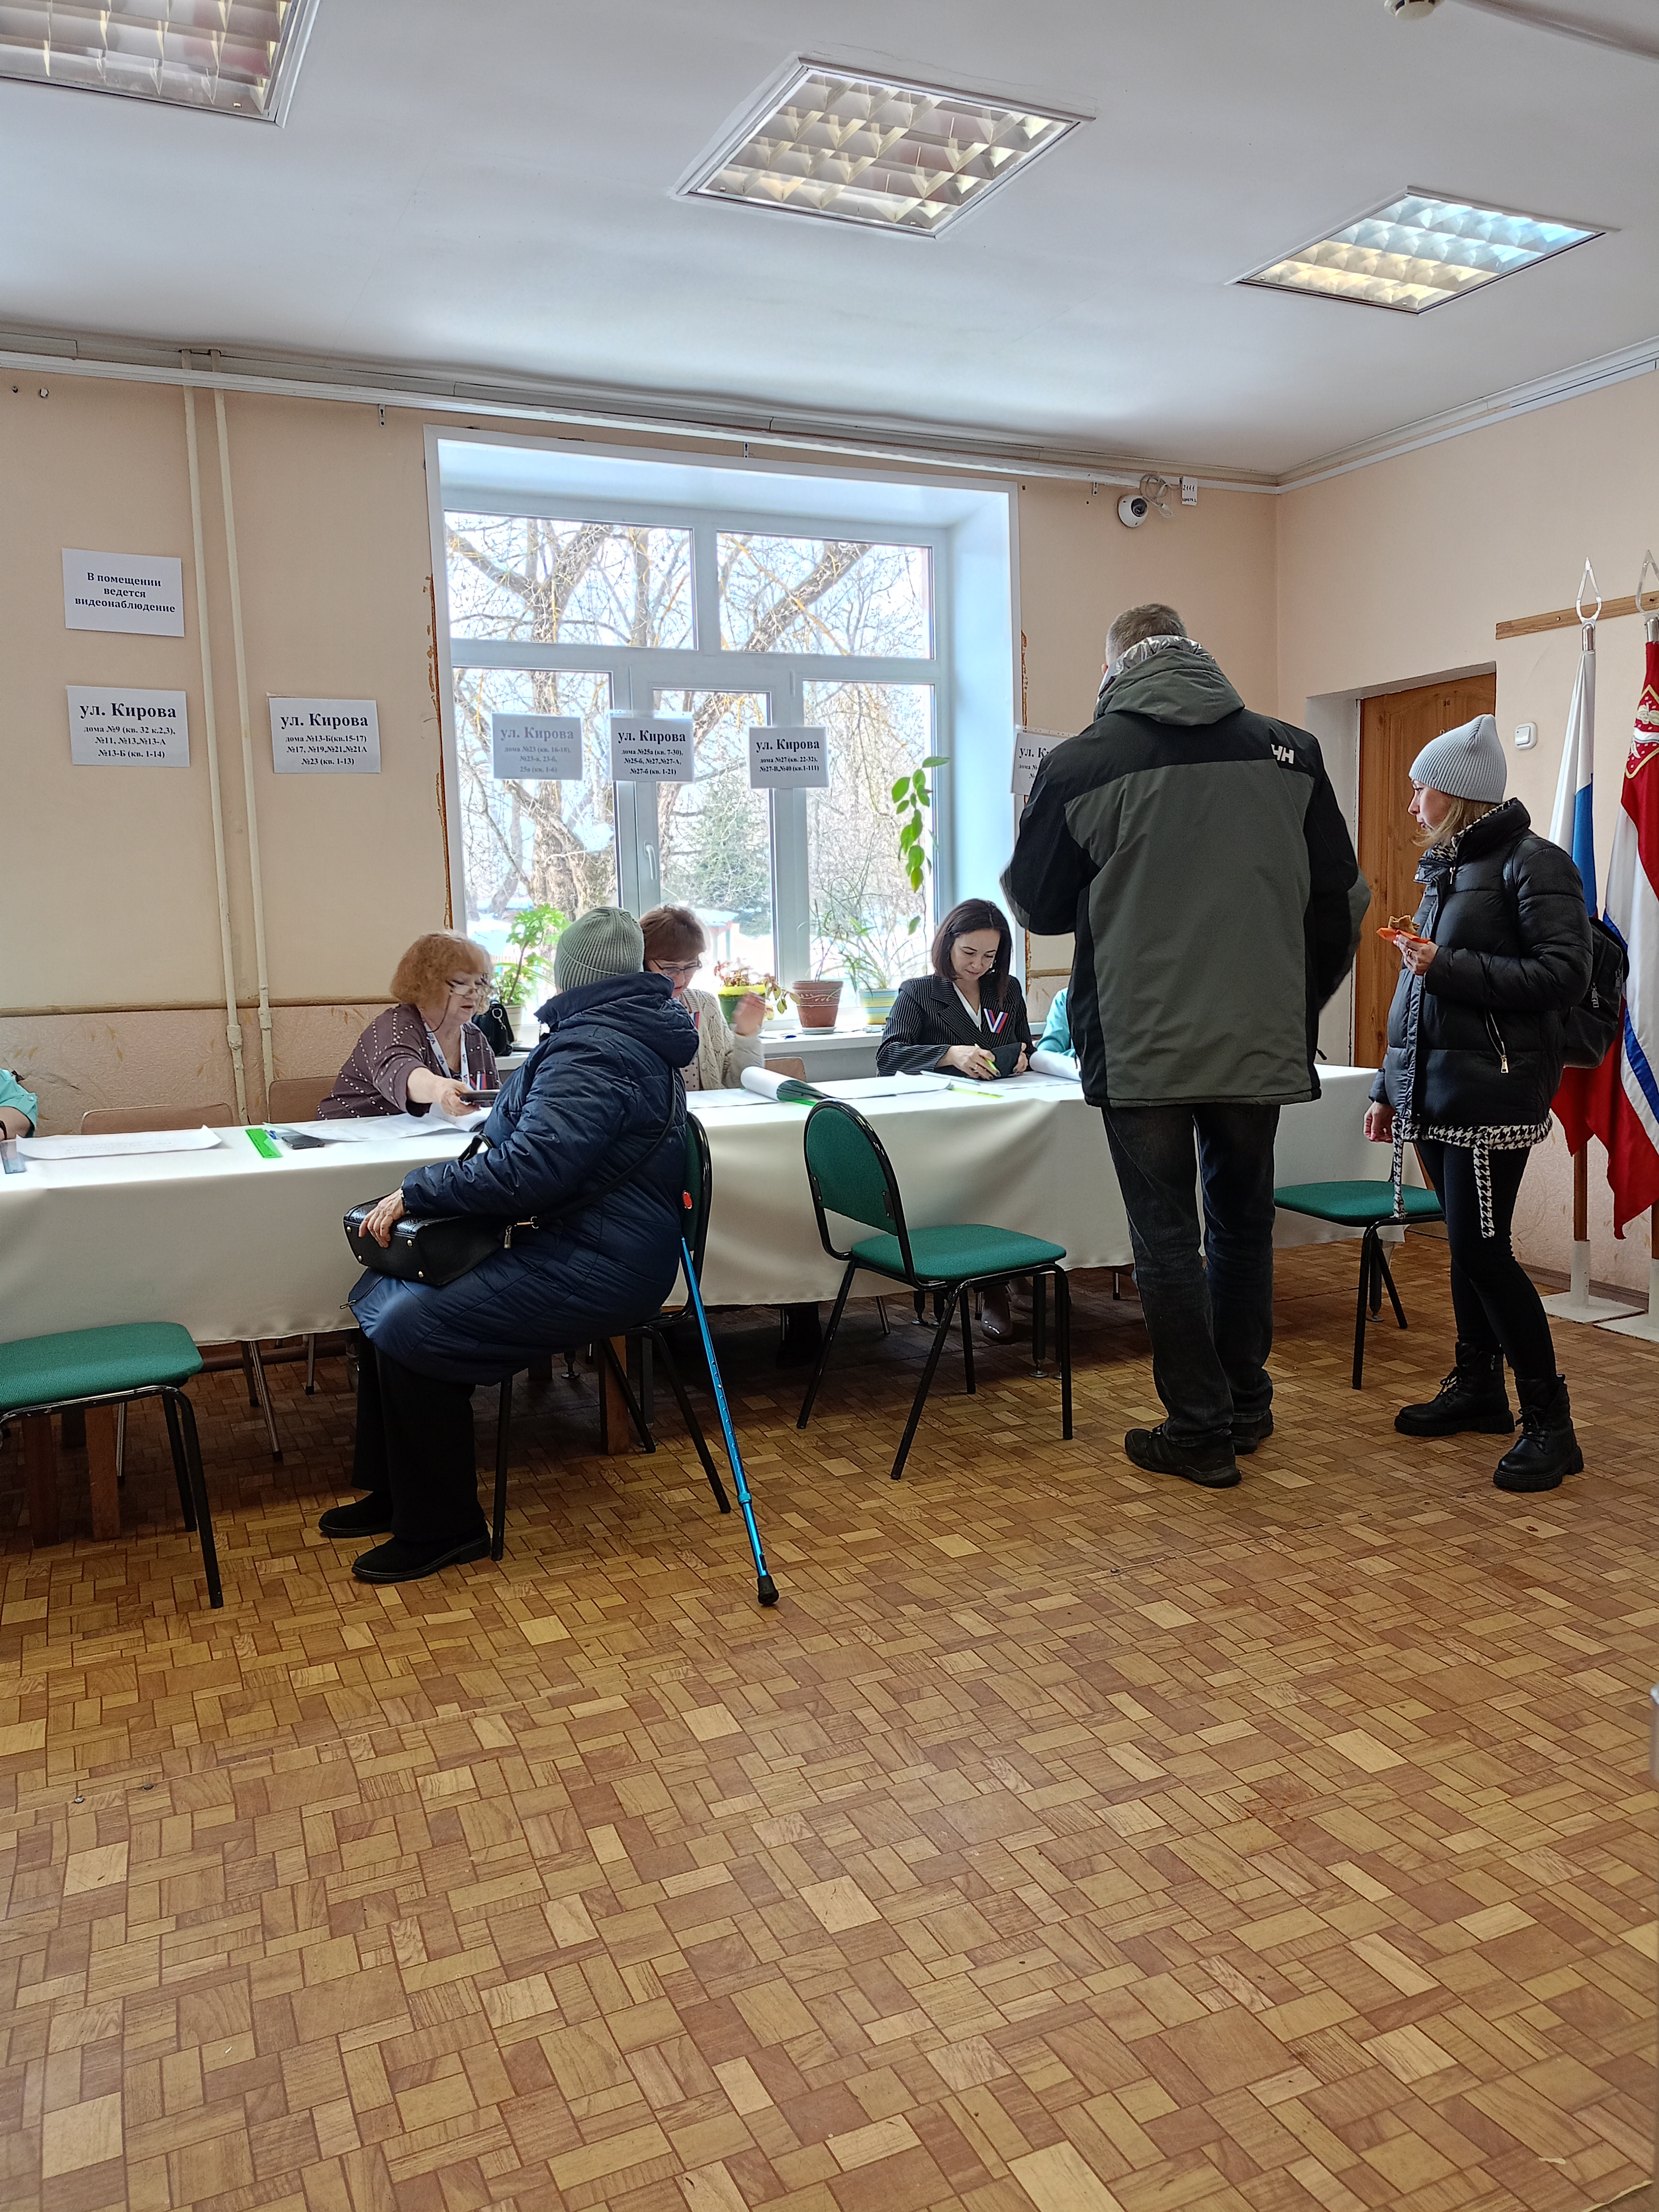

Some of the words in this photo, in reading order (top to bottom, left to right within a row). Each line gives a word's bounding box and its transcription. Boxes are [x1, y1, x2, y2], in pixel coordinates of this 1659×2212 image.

[87, 572, 94, 581] В
[97, 575, 161, 587] помещении
[104, 588, 146, 598] ведется
[75, 597, 176, 612] видеонаблюдение
[79, 706, 106, 719] ул.
[111, 703, 177, 721] Кирова
[280, 717, 304, 730] ул.
[309, 713, 368, 730] Кирова
[500, 729, 520, 741] ул.
[524, 727, 574, 742] Кирова
[618, 732, 636, 744] ул.
[639, 730, 686, 745] Кирова
[756, 742, 773, 753] ул.
[776, 739, 820, 752] Кирова
[1019, 748, 1034, 759] ул.
[146, 751, 165, 759] 1-14)
